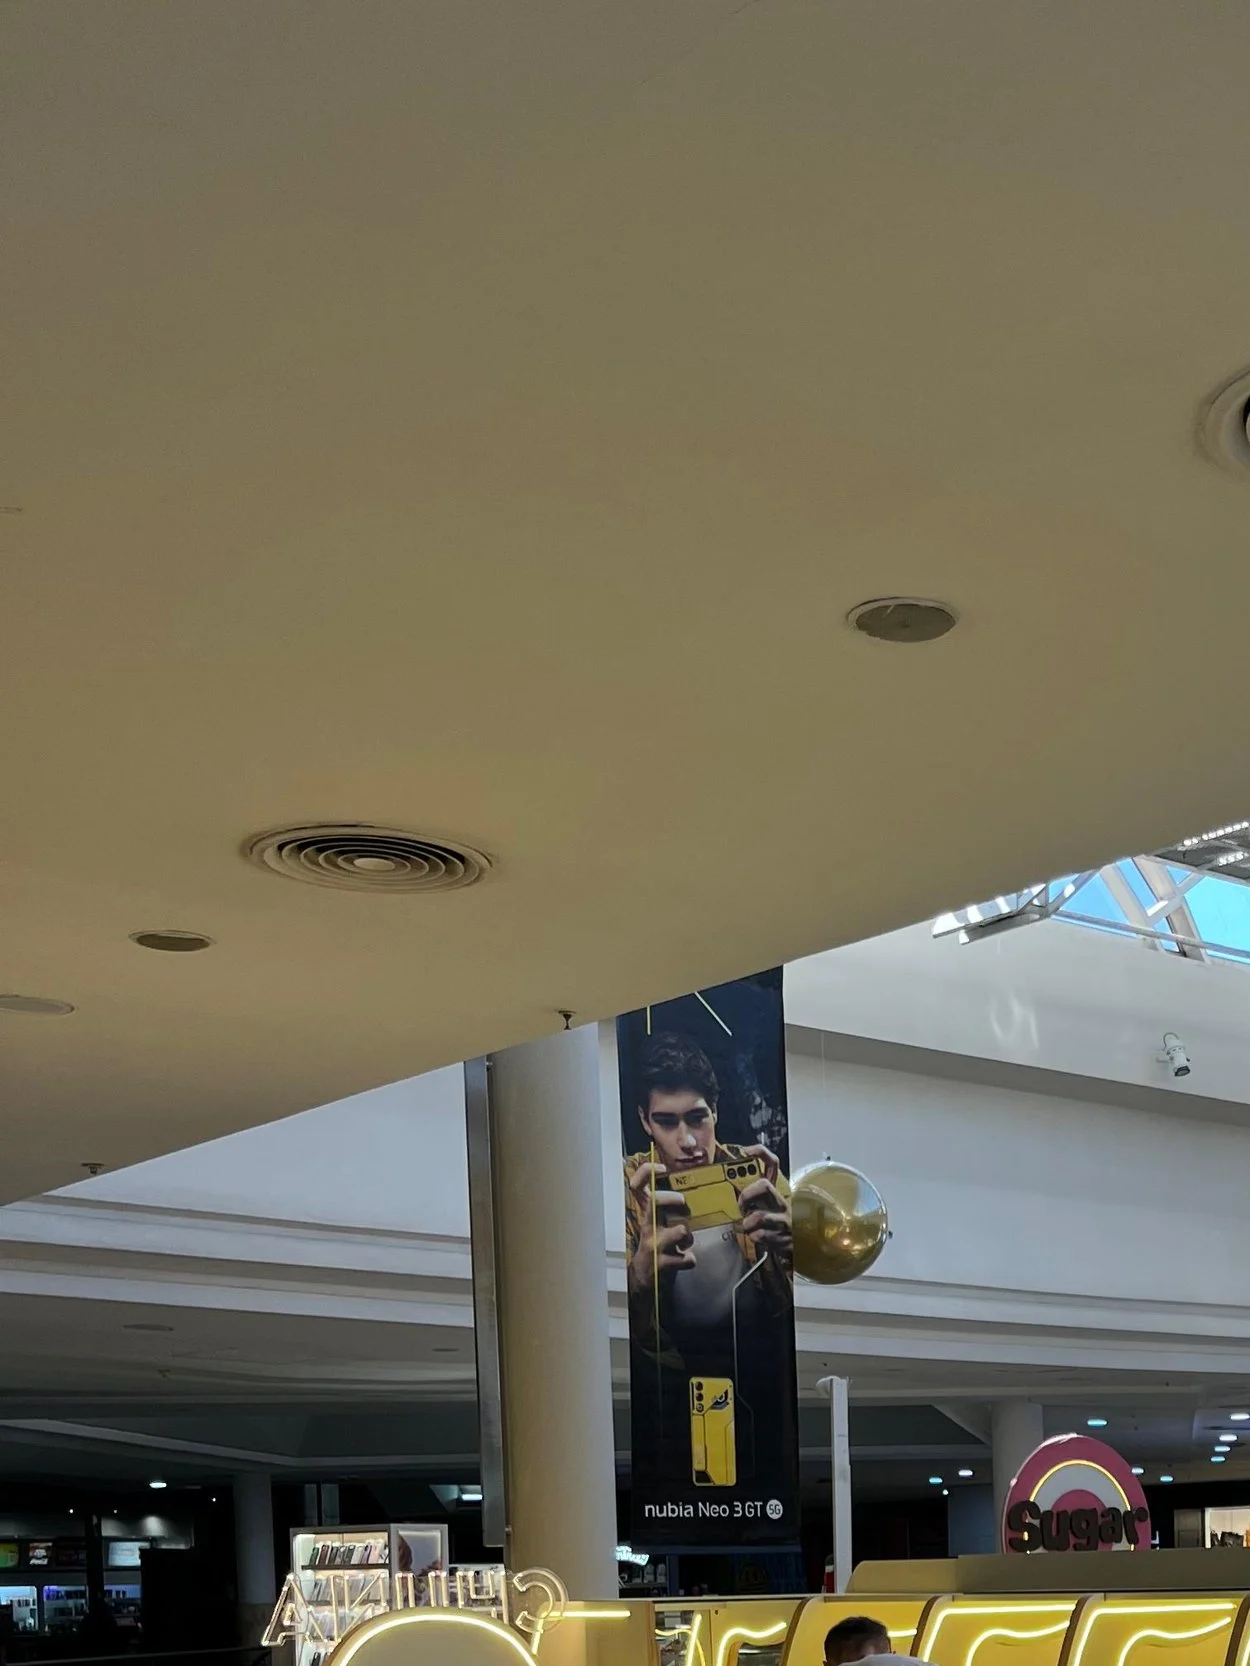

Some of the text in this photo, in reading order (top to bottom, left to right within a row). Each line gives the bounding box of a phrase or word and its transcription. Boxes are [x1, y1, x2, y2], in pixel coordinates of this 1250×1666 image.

[644, 1501, 694, 1517] nubia
[698, 1501, 729, 1517] Neo
[733, 1501, 743, 1517] 3
[745, 1501, 763, 1517] GT
[1008, 1501, 1149, 1552] Sugar
